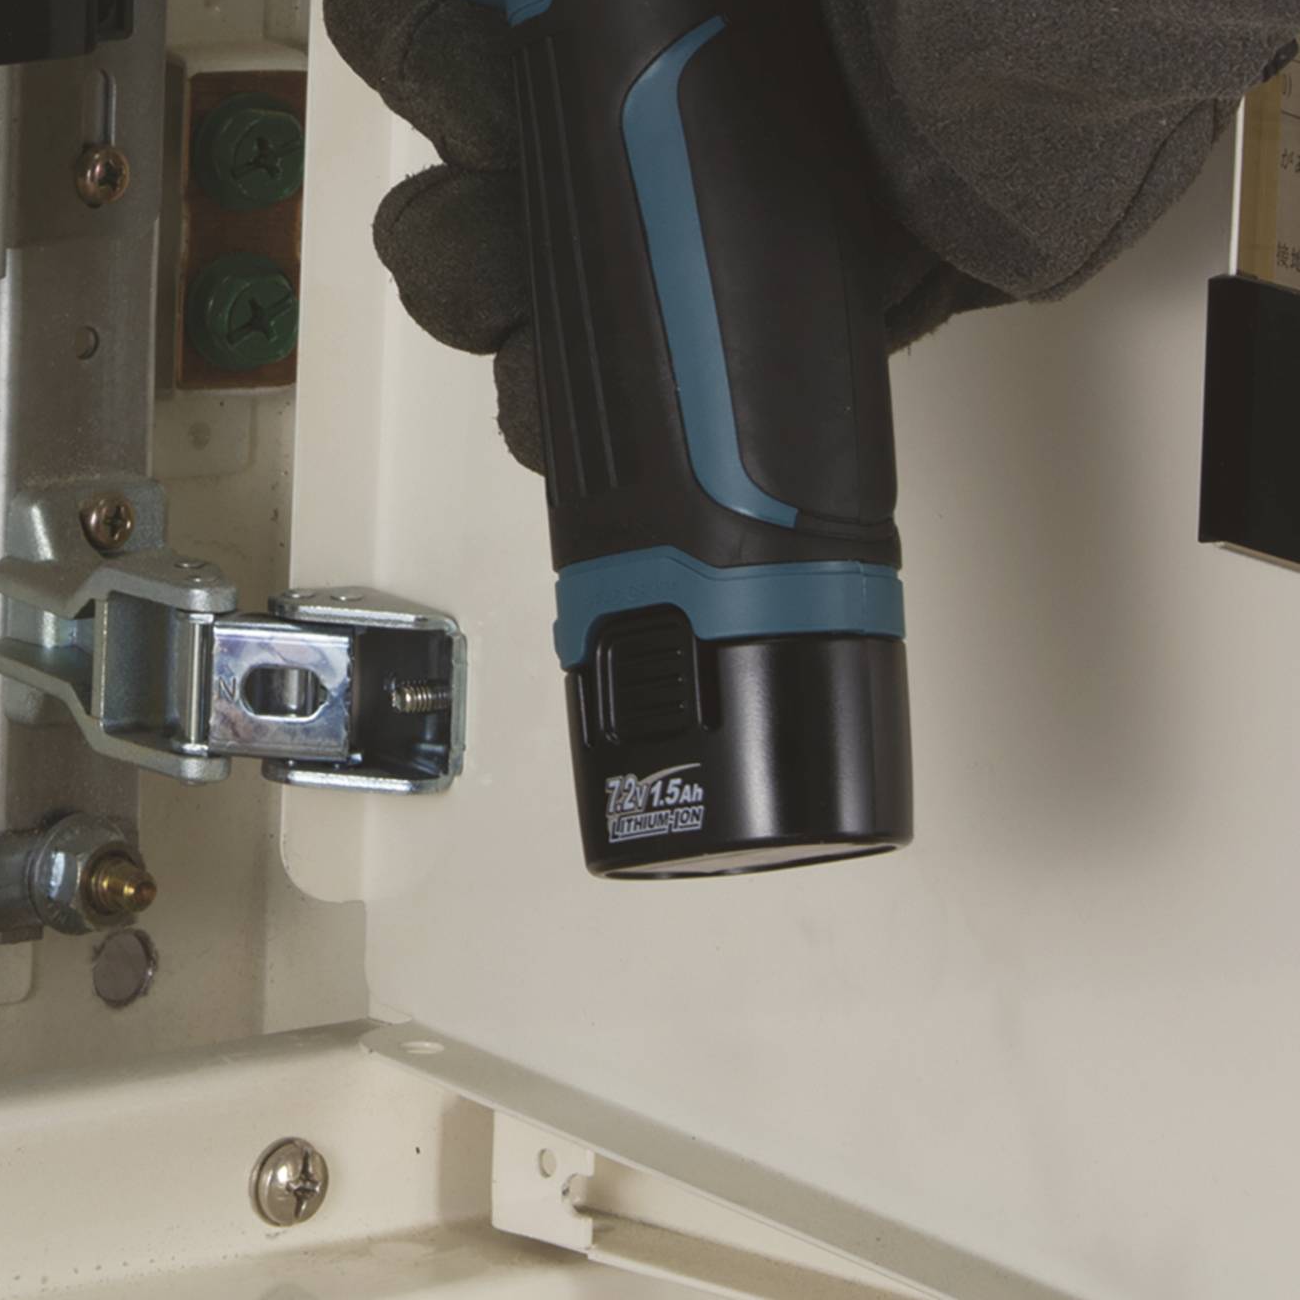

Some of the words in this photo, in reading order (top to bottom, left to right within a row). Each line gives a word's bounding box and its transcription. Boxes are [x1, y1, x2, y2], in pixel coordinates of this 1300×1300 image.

[606, 775, 649, 816] 7.2V
[650, 778, 704, 807] 1.5Ah
[609, 806, 704, 843] LITHIUM-ION
